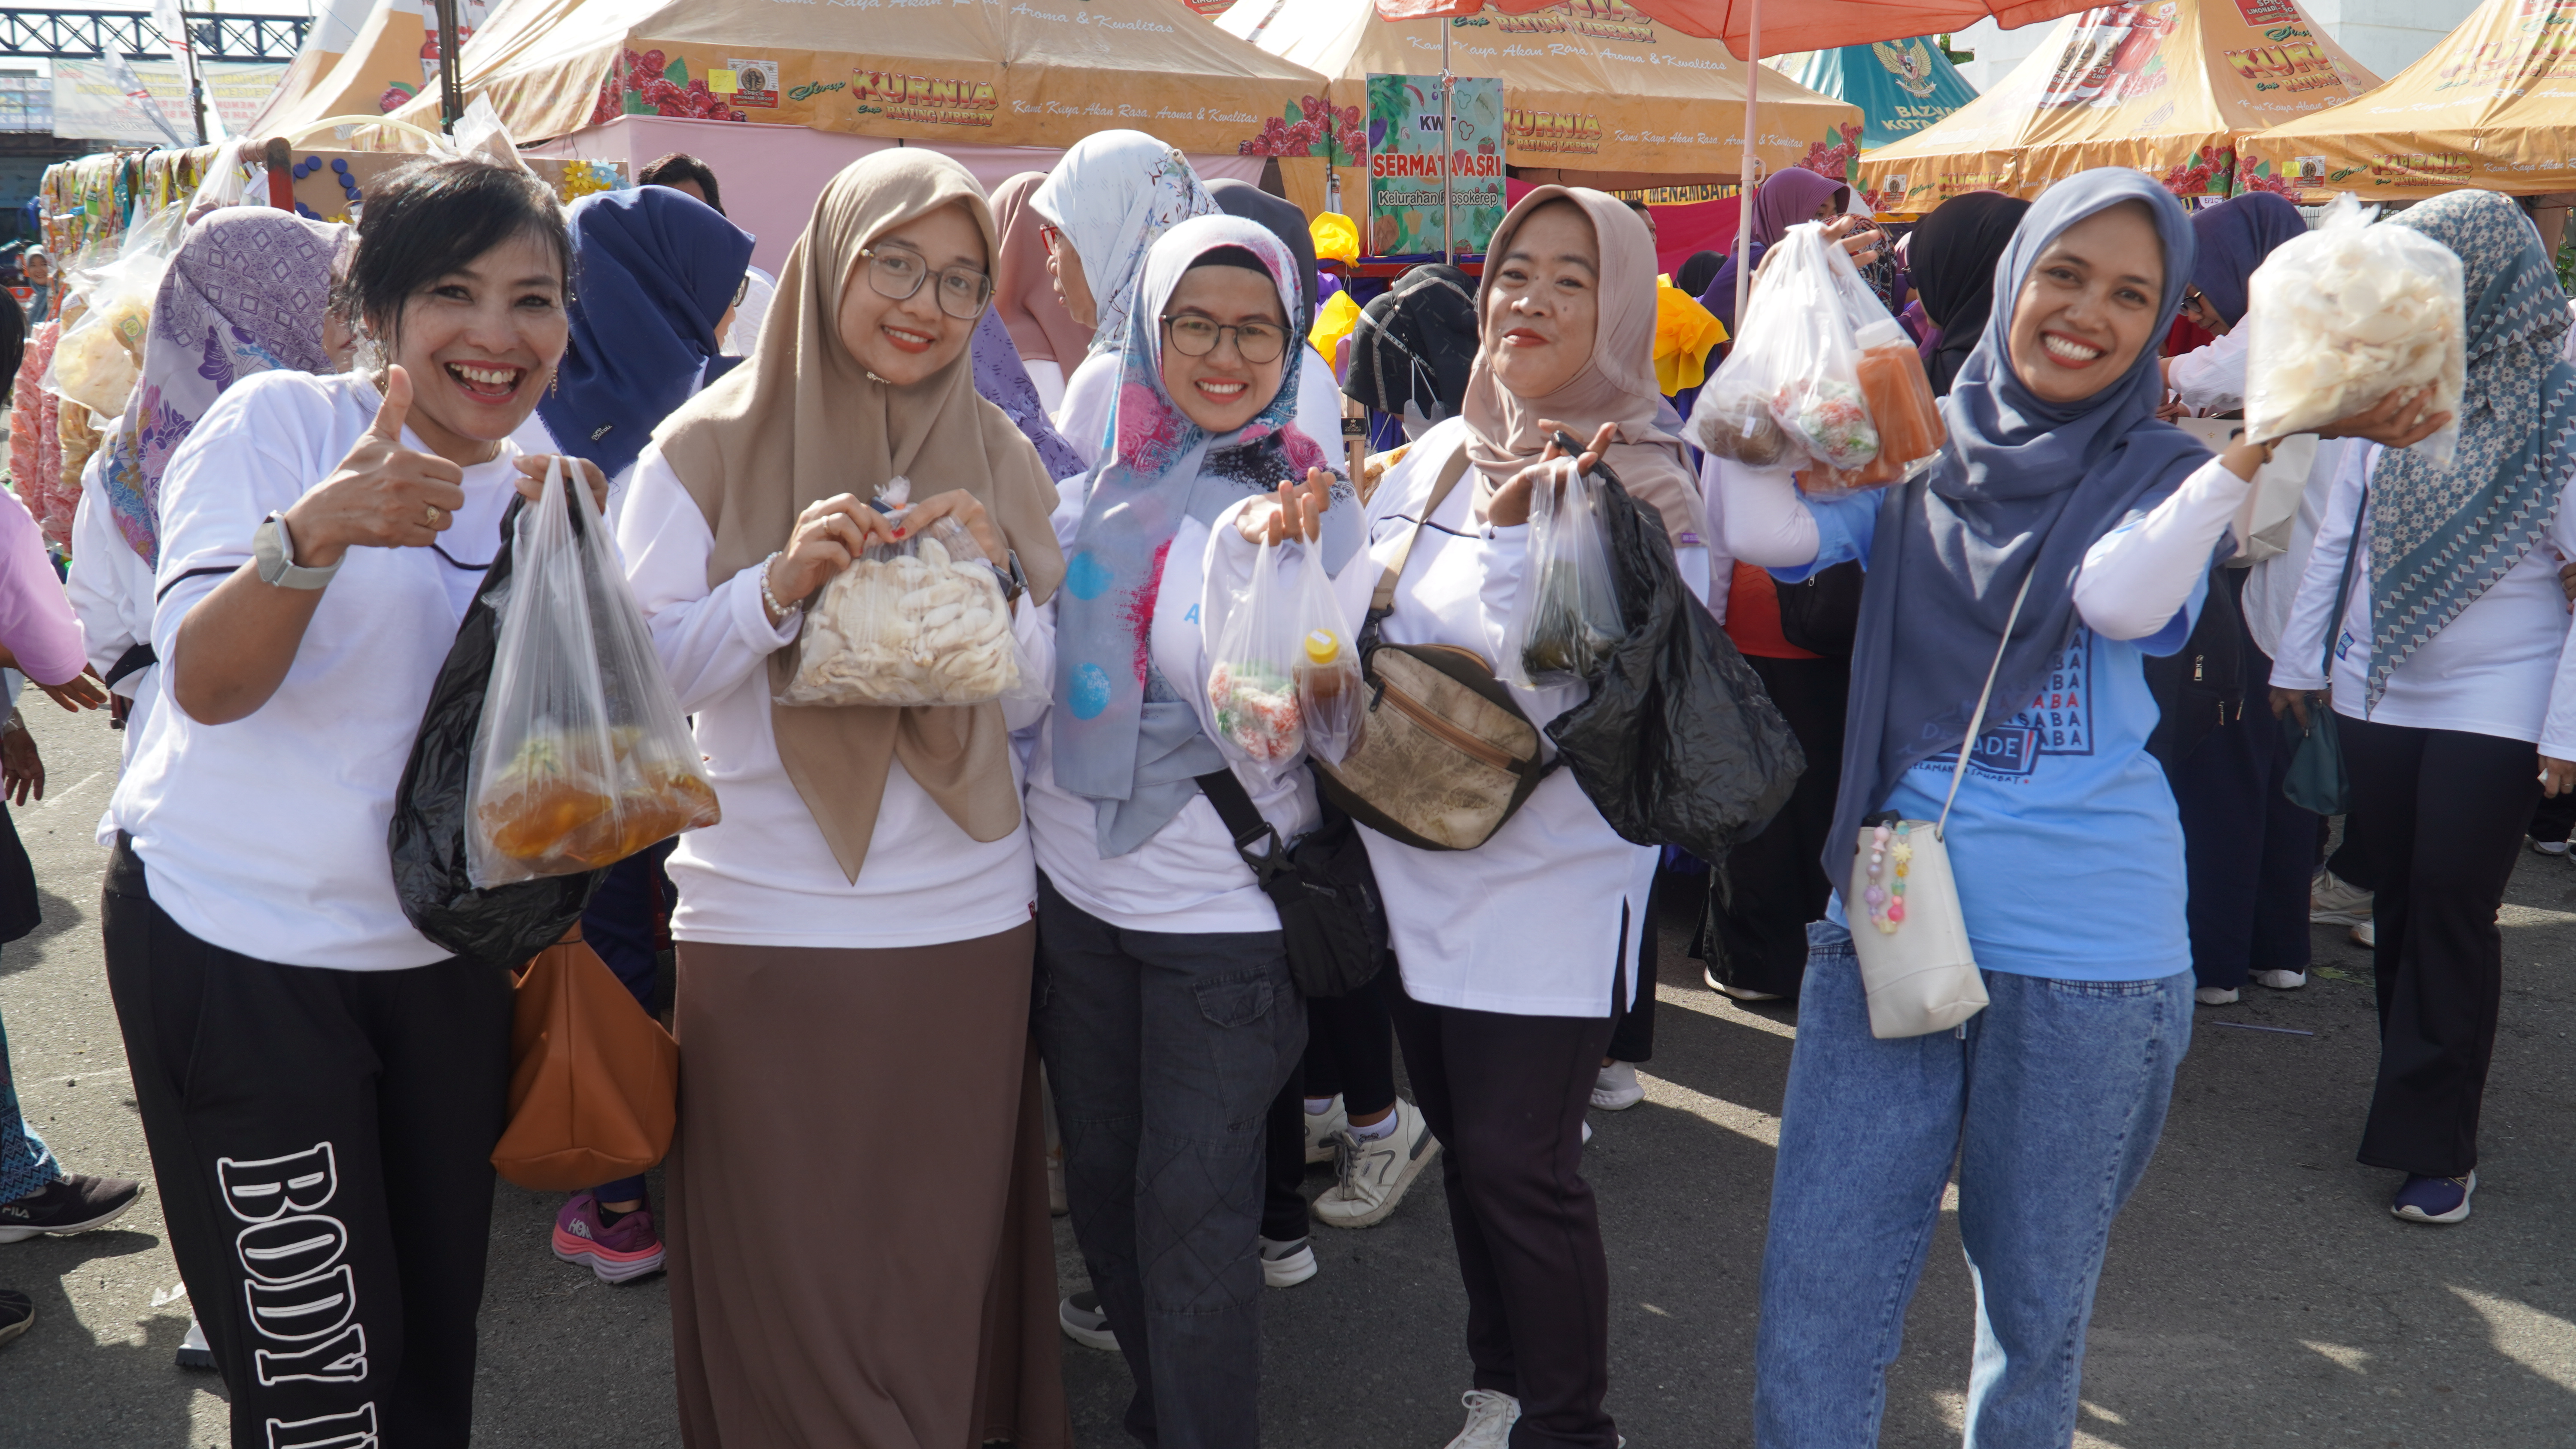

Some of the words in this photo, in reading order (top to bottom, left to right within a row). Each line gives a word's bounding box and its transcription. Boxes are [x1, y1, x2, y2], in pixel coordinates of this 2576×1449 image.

[1011, 3, 1069, 23] Aroma
[1076, 12, 1089, 24] &
[1452, 16, 1490, 27] Cap
[1573, 21, 1656, 43] LIBERTY
[1503, 44, 1544, 57] Akan
[1600, 48, 1645, 63] Aroma
[1649, 53, 1660, 64] &
[852, 67, 999, 110] KURNIA
[2256, 82, 2279, 91] Cap
[2281, 73, 2342, 92] PATUNG
[857, 104, 882, 114] Cap
[886, 106, 937, 123] PATUNG
[939, 110, 994, 127] LIBERTY
[1012, 100, 1042, 113] Kami
[1082, 102, 1114, 116] Akan
[1155, 106, 1193, 120] Aroma
[1197, 107, 1205, 120] &
[2297, 101, 2323, 111] Akan
[1517, 139, 1558, 152] PATUNG
[1559, 141, 1599, 154] LIBERTY
[1615, 130, 1639, 142] Kami
[1641, 131, 1666, 145] Kaya
[1668, 132, 1694, 143] Akan
[1759, 134, 1766, 145] &
[1463, 155, 1501, 177] ASRI
[2371, 152, 2473, 176] KURNIA
[2483, 162, 2508, 173] Kami
[2509, 161, 2536, 173] Kaya
[2539, 159, 2564, 171] Akan
[2394, 176, 2429, 187] PATUNG
[2430, 175, 2471, 186] LIBERTY
[1378, 190, 1439, 206] Kelurahan
[1440, 190, 1499, 207] osokerep
[2, 1204, 30, 1219] FILA
[217, 1142, 368, 1386] BODY
